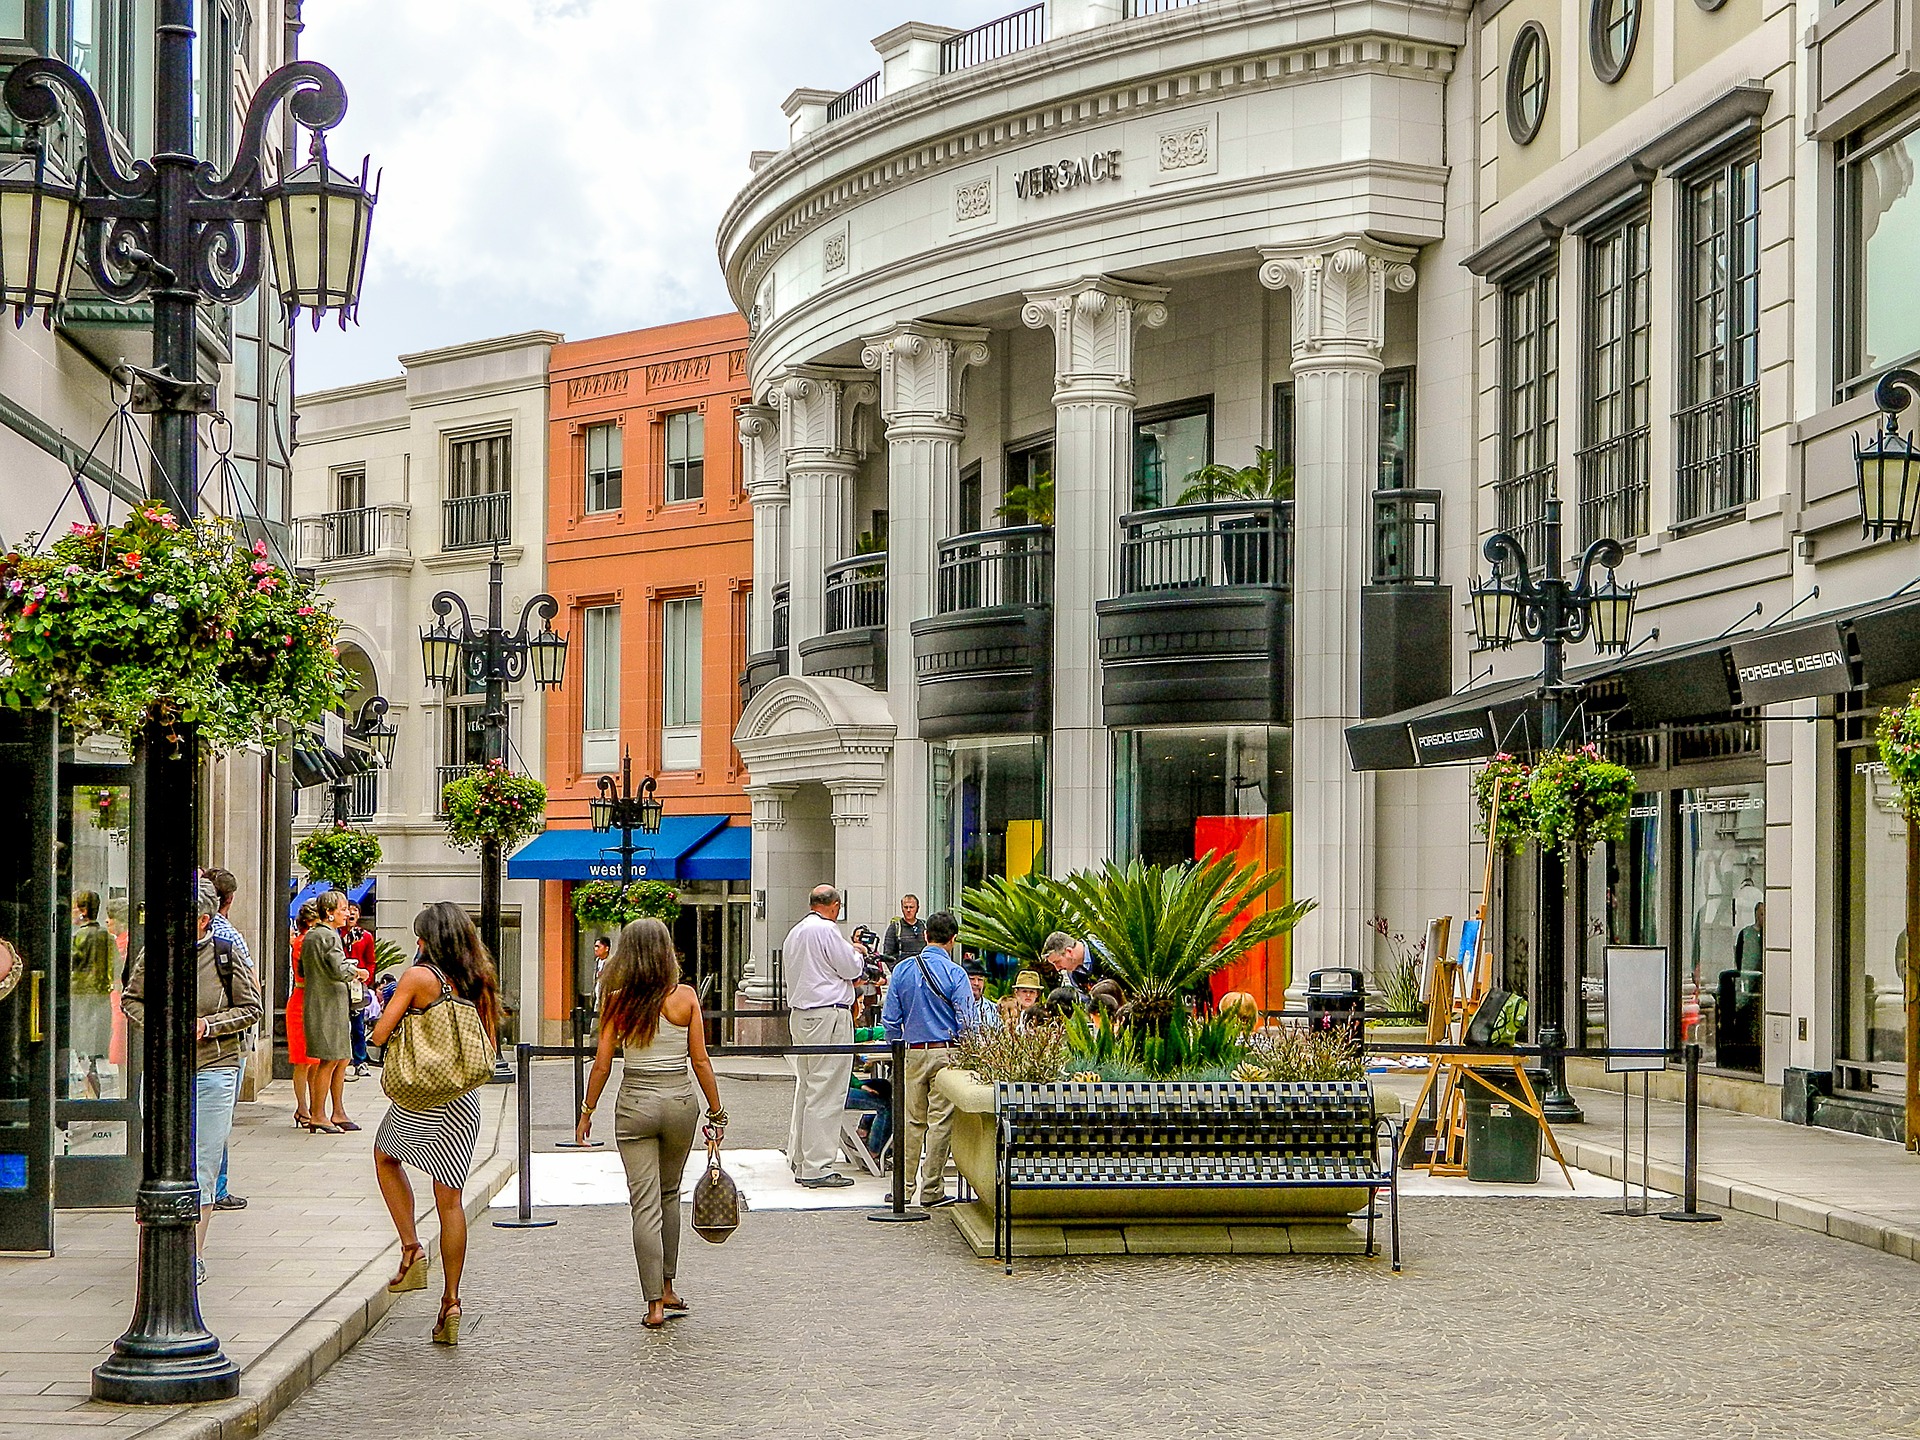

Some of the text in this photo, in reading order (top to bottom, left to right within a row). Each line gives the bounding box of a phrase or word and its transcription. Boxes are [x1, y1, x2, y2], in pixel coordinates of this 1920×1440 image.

[1013, 149, 1122, 199] VERSACE
[1738, 650, 1843, 682] PORSCHE DESIGN
[1418, 727, 1485, 748] PORSCHE DESIGN
[1679, 801, 1726, 814] PORSCHE
